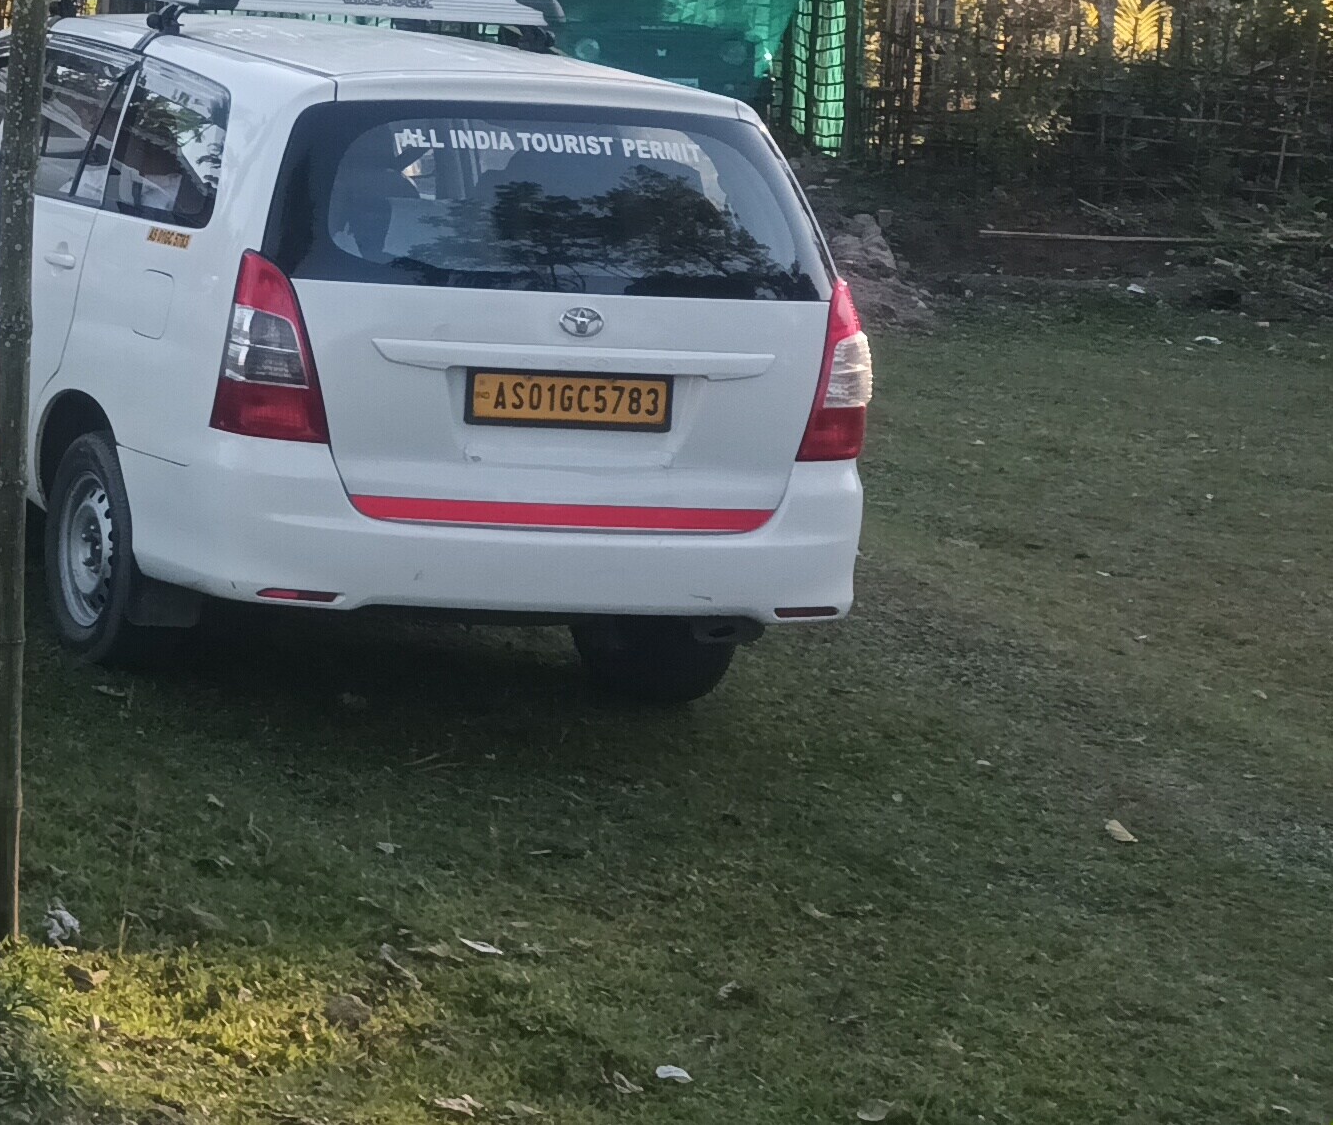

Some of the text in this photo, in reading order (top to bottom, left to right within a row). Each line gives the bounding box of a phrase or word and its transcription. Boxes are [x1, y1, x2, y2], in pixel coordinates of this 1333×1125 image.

[402, 129, 700, 163] ALL INDIA TOURIST PERMIT
[493, 381, 660, 416] AS01GC5783
